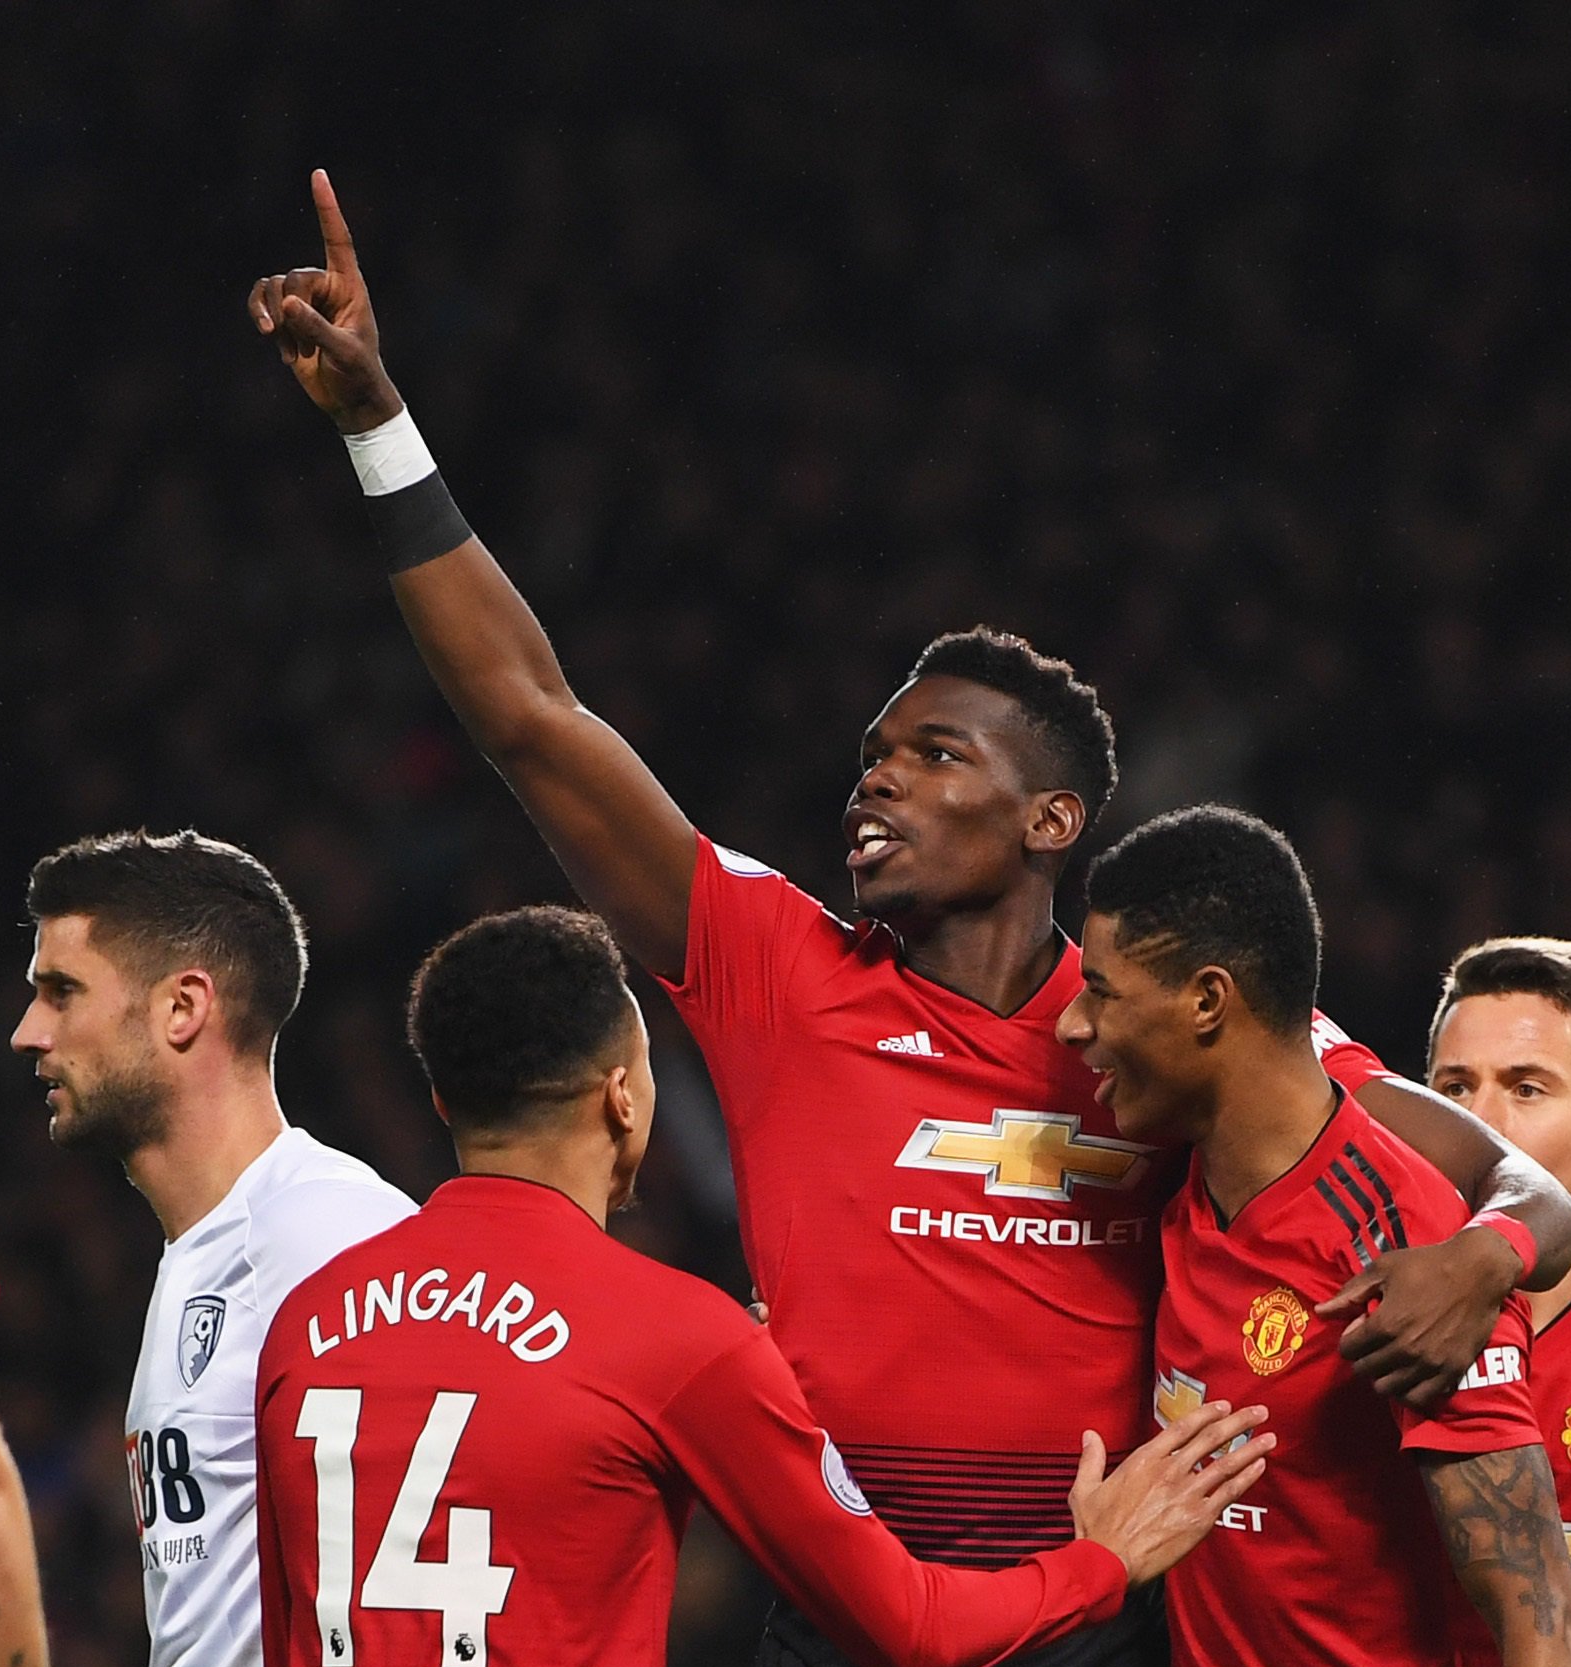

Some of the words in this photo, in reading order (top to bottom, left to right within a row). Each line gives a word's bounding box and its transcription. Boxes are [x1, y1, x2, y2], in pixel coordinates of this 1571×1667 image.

[890, 1206, 1147, 1246] CHEVROLET
[308, 1268, 570, 1363] LINGARD
[1458, 1346, 1522, 1391] LER
